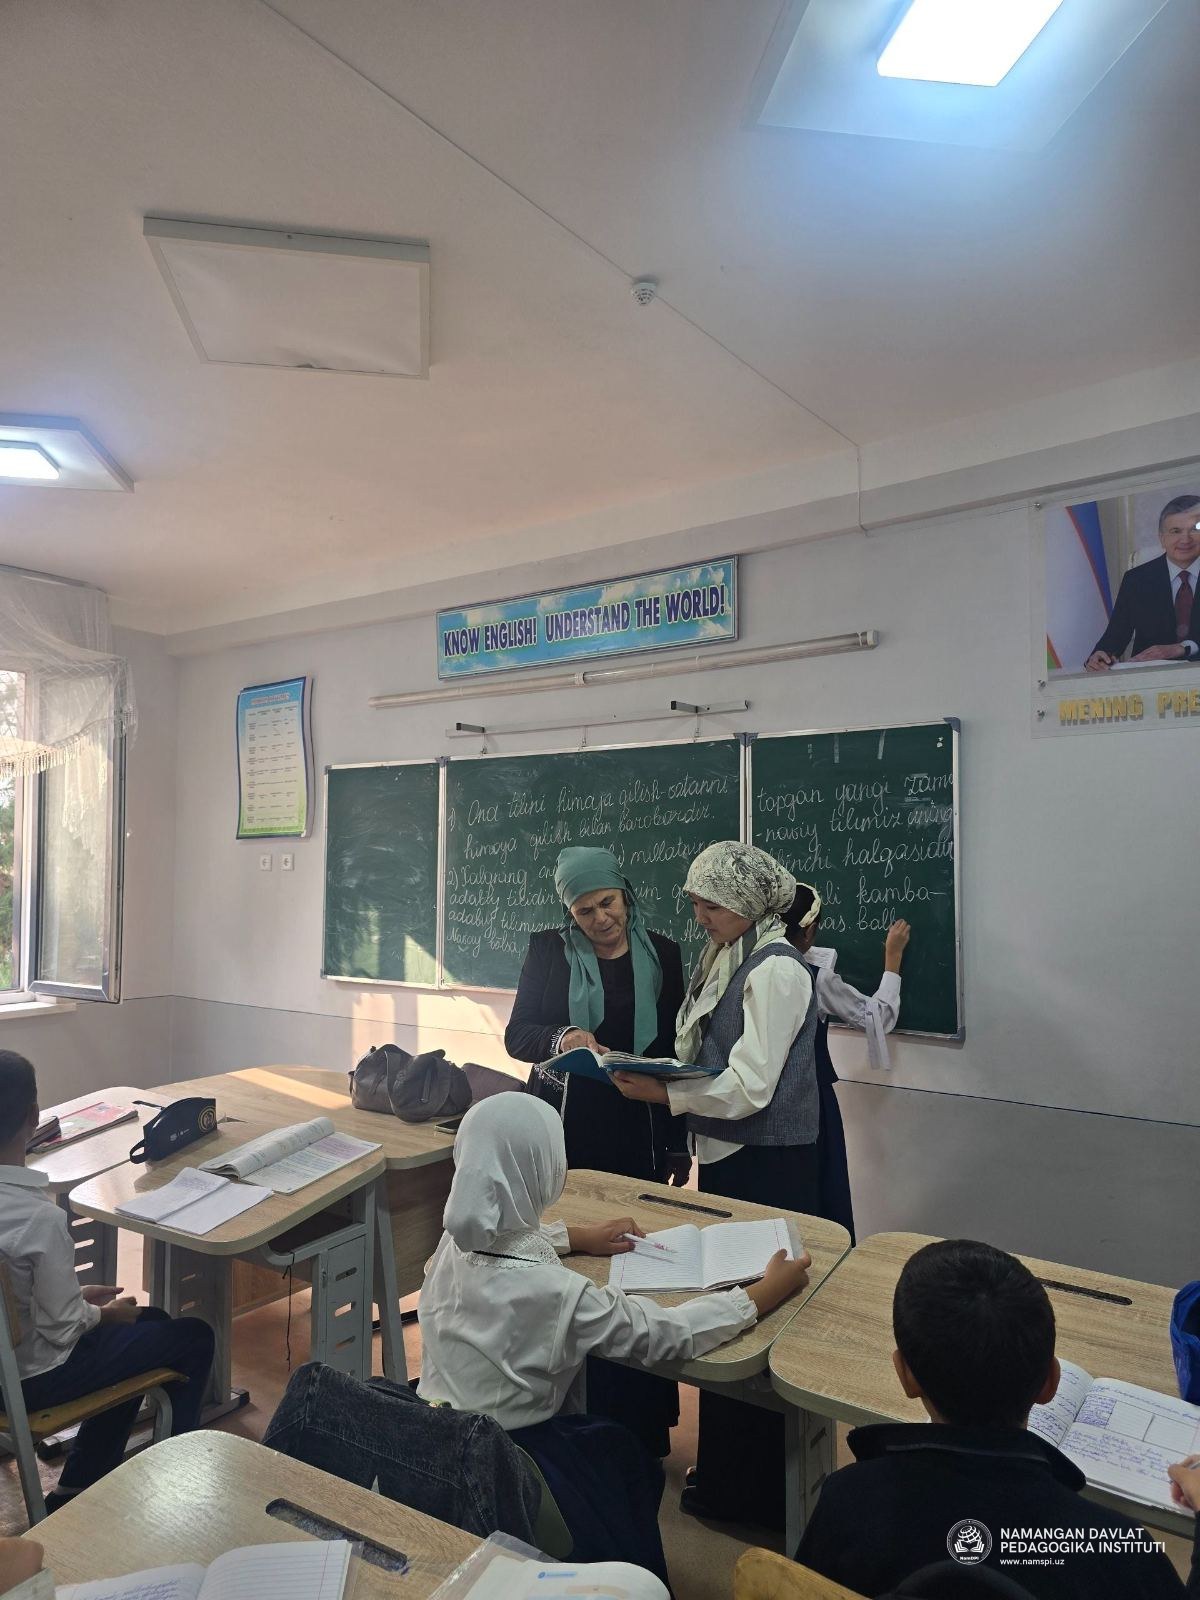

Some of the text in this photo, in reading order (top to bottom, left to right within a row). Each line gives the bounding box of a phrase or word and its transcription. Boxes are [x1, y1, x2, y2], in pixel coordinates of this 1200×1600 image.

[443, 583, 726, 657] KNOW ENGLISH! UNDERSTAND THE WORLD!
[1059, 694, 1144, 722] MENING
[835, 775, 892, 816] yangi
[467, 799, 500, 827] Ona
[830, 807, 902, 833] tilimiz
